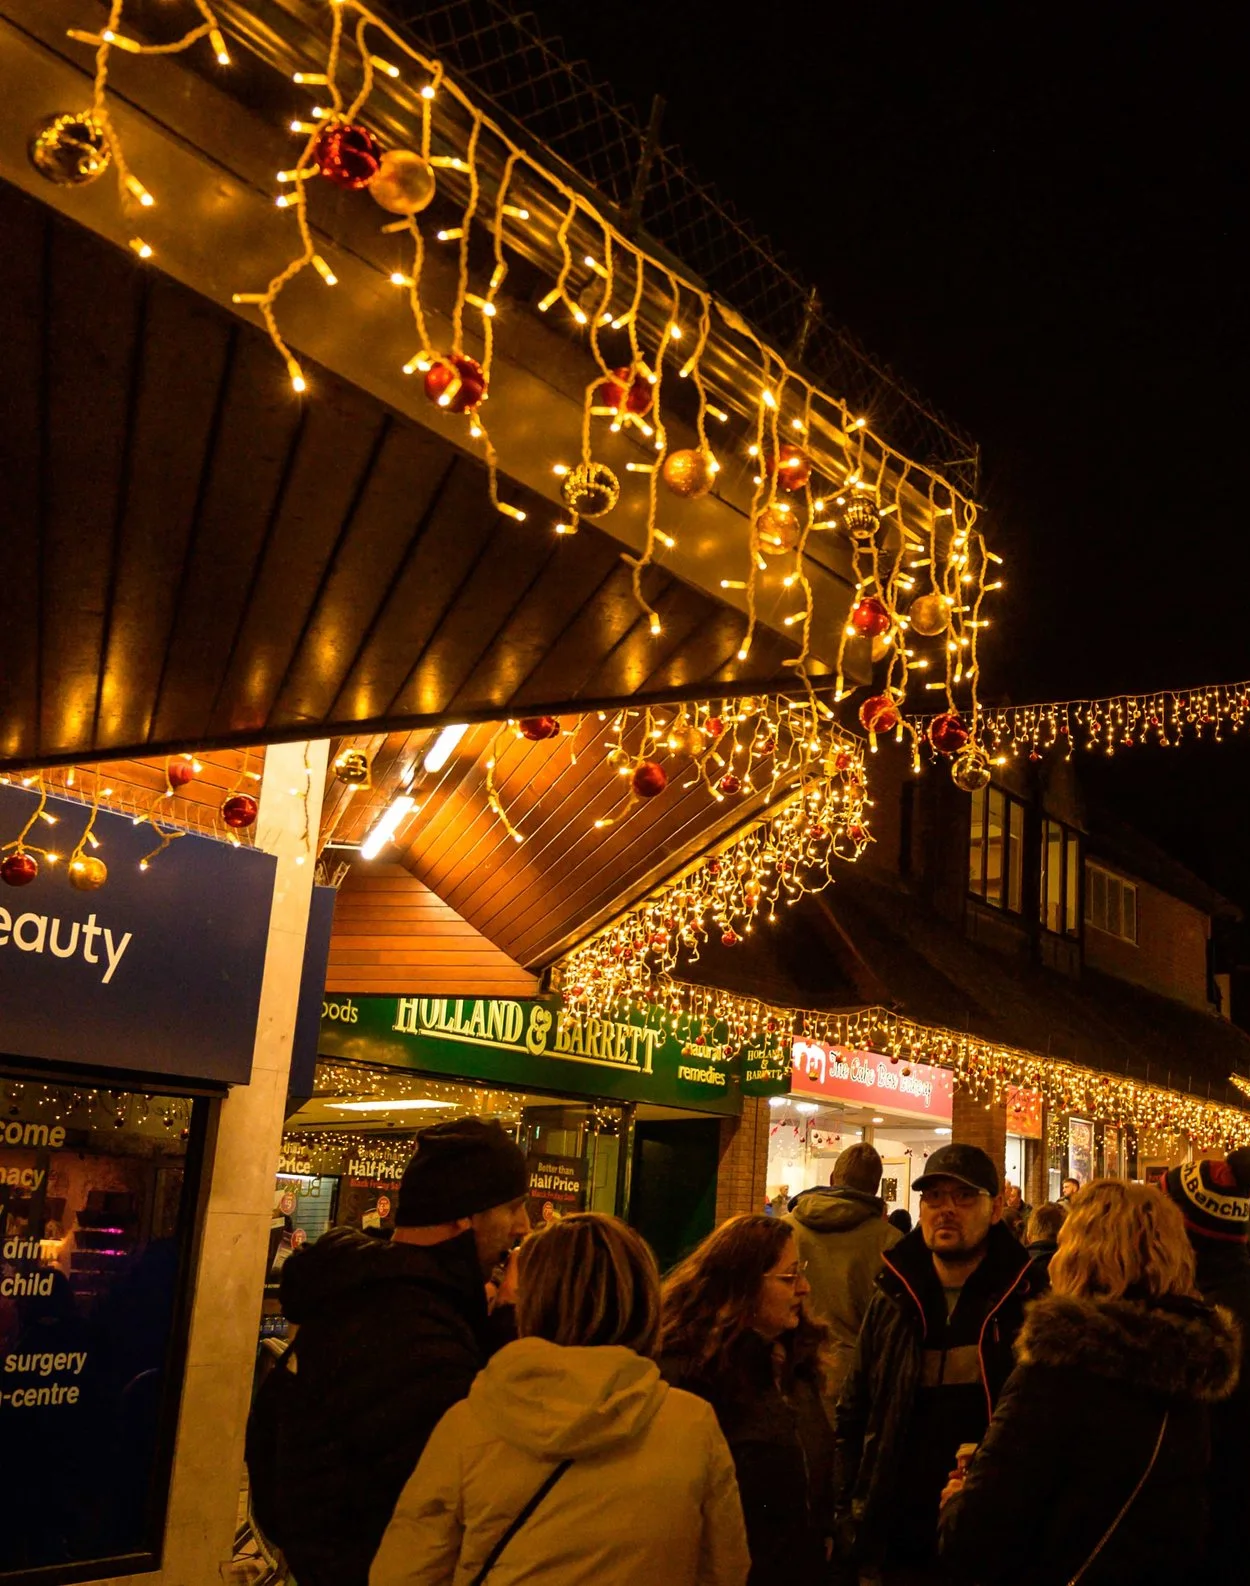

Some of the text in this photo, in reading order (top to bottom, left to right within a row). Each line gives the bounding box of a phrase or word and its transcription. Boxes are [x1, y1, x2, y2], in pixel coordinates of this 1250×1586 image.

[392, 998, 660, 1074] HOLLAND & BARRETT
[678, 1065, 726, 1086] remedies
[348, 1159, 403, 1179] Half Pric
[538, 1162, 575, 1176] Better than
[529, 1173, 580, 1193] Half Price
[1, 1273, 54, 1296] child
[4, 1352, 87, 1376] surgery
[0, 1382, 80, 1407] -centre
